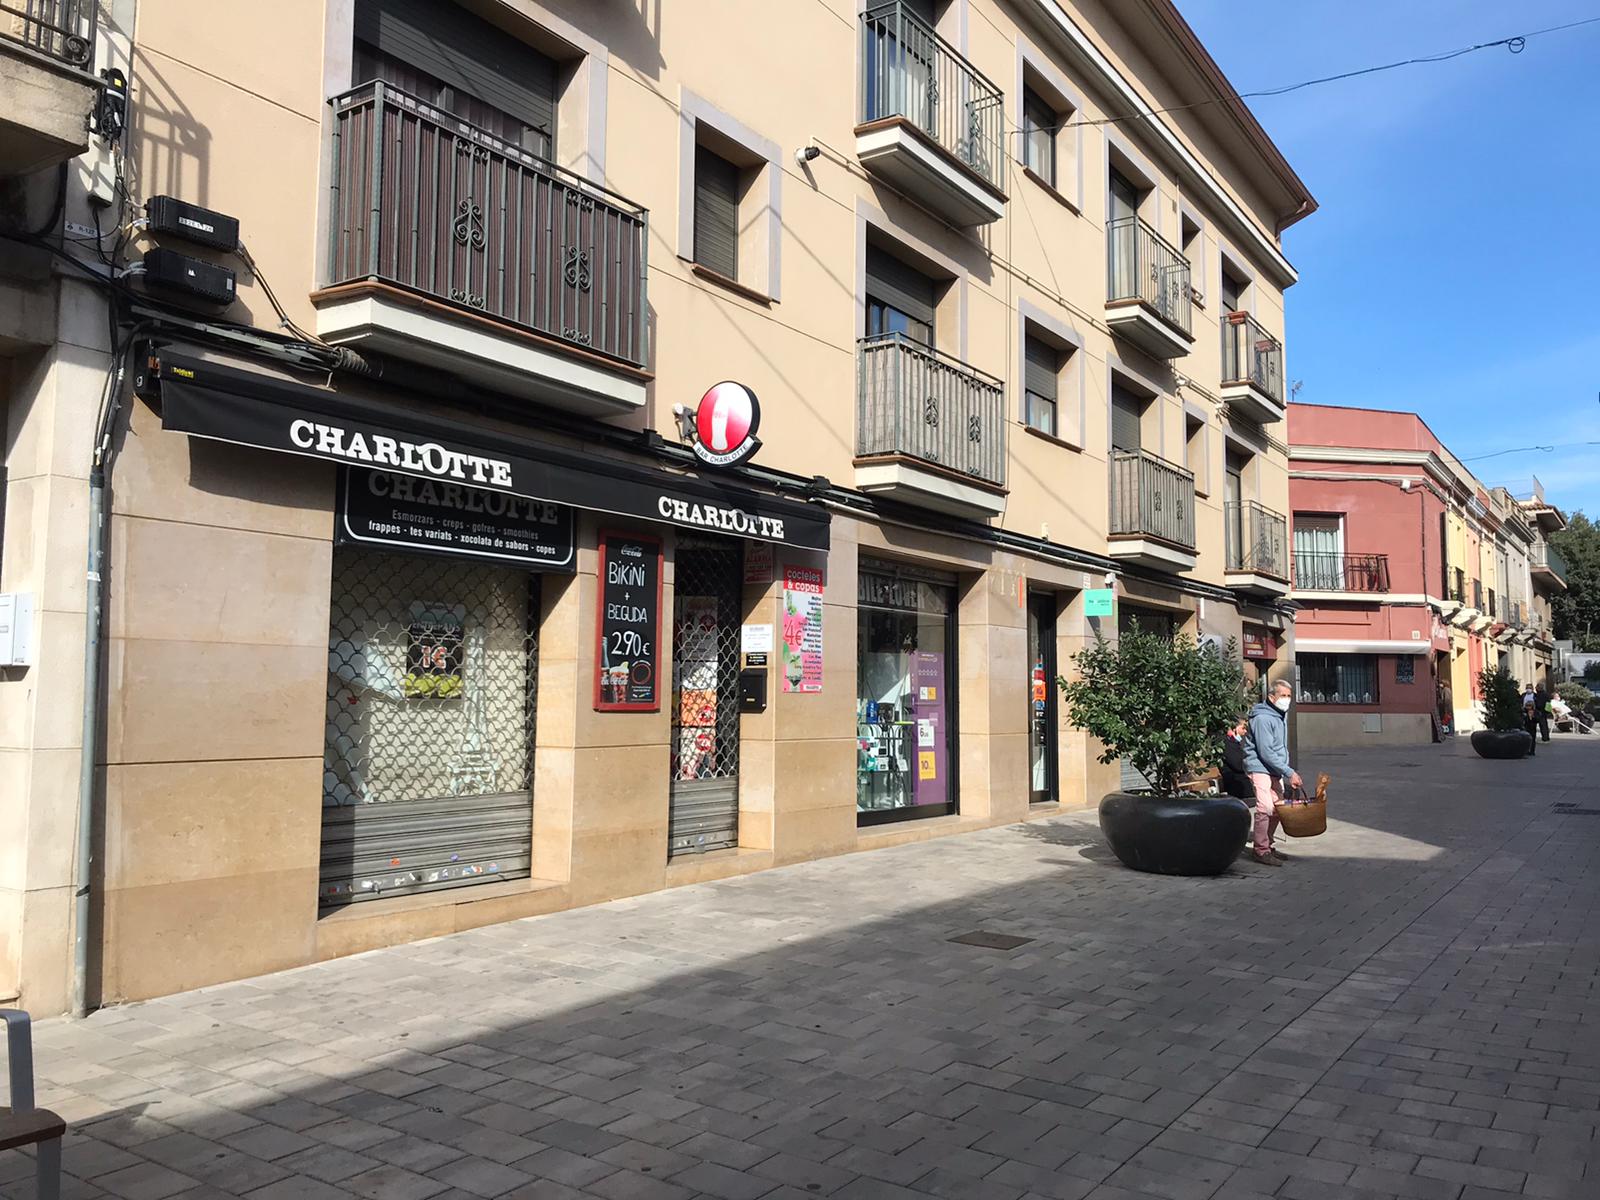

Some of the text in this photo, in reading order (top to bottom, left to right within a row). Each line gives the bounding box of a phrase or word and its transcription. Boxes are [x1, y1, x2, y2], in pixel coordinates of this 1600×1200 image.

[290, 419, 512, 487] CHARLOTTE
[696, 444, 747, 463] BAR CHARLOTTE
[368, 471, 558, 524] CHARLOTTE
[392, 509, 434, 525] Esmorzars
[443, 519, 464, 530] creps
[503, 527, 539, 540] smoothies
[658, 496, 785, 539] CHARLOTTE
[368, 520, 401, 534] frappes
[410, 527, 422, 537] tes
[460, 535, 492, 547] xocolata
[494, 538, 504, 548] de
[505, 540, 529, 551] sabors
[536, 544, 556, 555] copes
[788, 580, 820, 592] & copas
[607, 603, 647, 623] BEGUDA
